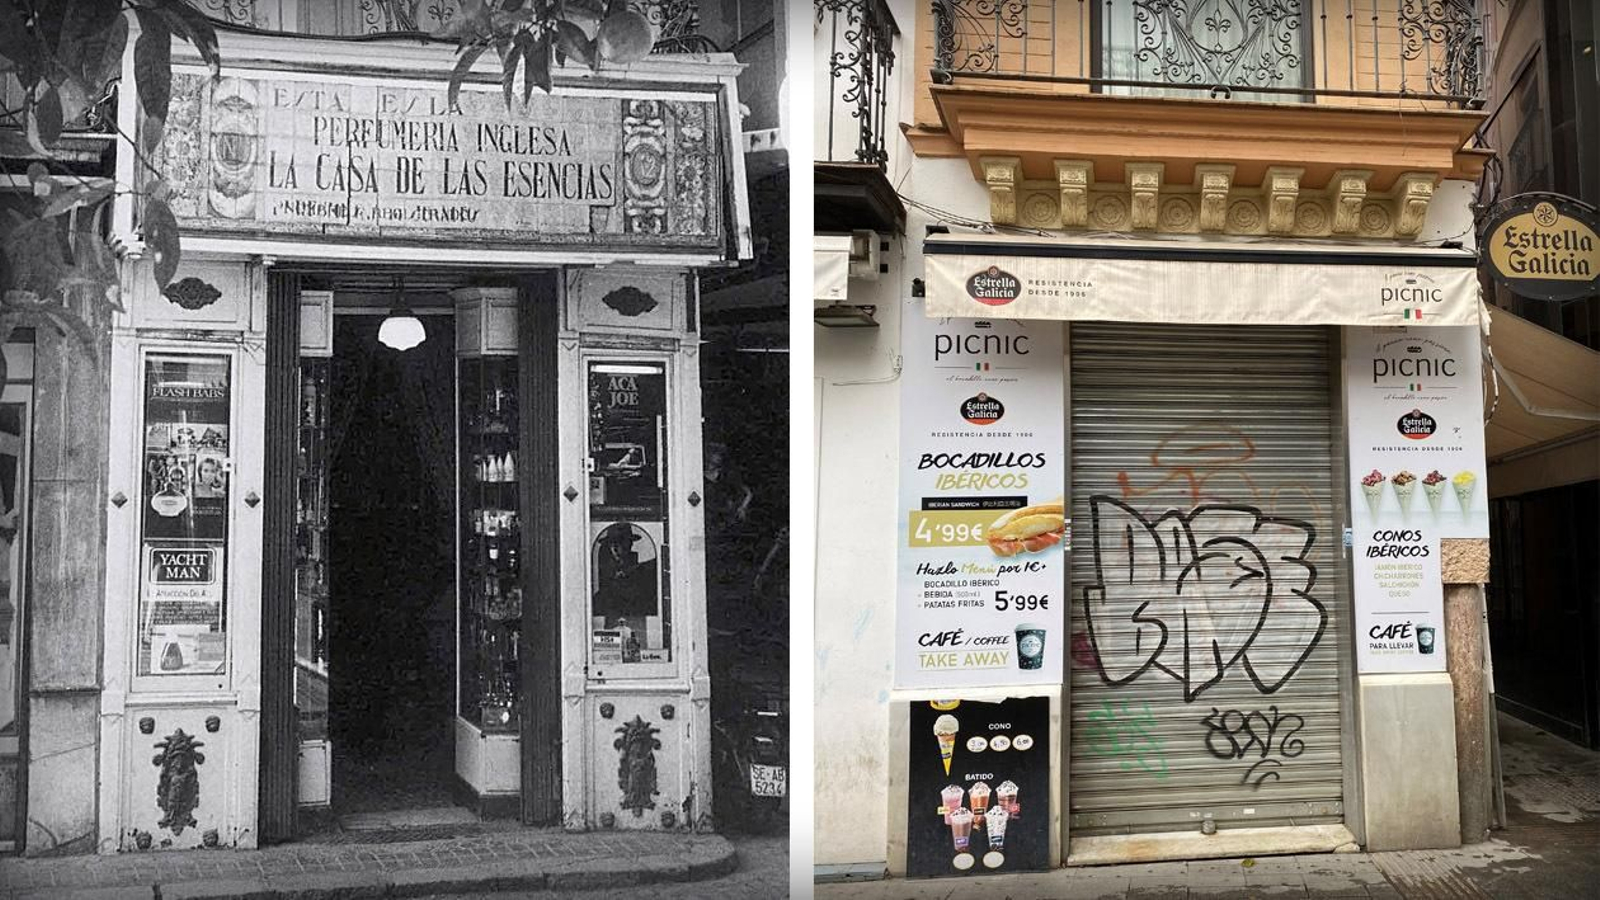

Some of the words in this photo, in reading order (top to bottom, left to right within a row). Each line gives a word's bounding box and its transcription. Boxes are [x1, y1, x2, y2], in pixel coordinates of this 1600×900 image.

[313, 116, 459, 152] PERFUMERIA
[477, 123, 571, 157] INGLESA
[268, 150, 298, 189] LA
[315, 152, 379, 194] CASA
[395, 155, 426, 195] DE
[442, 157, 488, 196] LAS
[502, 160, 613, 201] ESENCIAS
[1502, 225, 1593, 252] Estrella
[1508, 249, 1591, 276] Galicia
[973, 276, 1016, 288] Estrella
[1027, 279, 1094, 288] RESISTENCIA
[974, 287, 1015, 298] Galicia
[1027, 289, 1060, 297] DESDE
[1381, 287, 1443, 307] picnic
[934, 333, 1030, 361] picnic
[1373, 358, 1457, 384] picnic
[607, 376, 638, 391] ACA
[606, 391, 640, 409] JOE
[966, 401, 1000, 411] Estrella
[967, 409, 999, 419] Galicia
[1402, 417, 1433, 427] Estrella
[1403, 425, 1431, 434] Galicia
[917, 451, 1046, 470] BOCADILLOS
[935, 470, 1028, 491] IBÉRICOS
[1372, 529, 1423, 542] CONOS
[1366, 543, 1430, 559] IBÉRICOS
[159, 553, 208, 566] YACHT
[165, 566, 201, 579] MAN
[916, 560, 959, 576] Hazlo
[996, 562, 1022, 577] por
[923, 580, 968, 589] BOCADILLO
[969, 578, 1000, 587] IBÉRICO
[923, 590, 953, 599] BEBIDA
[923, 600, 956, 609] PATATAS
[957, 599, 985, 608] FRITAS
[1368, 620, 1413, 640] CAFÉ
[917, 628, 964, 648] CAFÉ
[973, 635, 1011, 645] COFFEE
[1369, 642, 1388, 650] PARA
[1389, 642, 1414, 650] LLEVAR
[918, 653, 958, 669] TAKE
[963, 651, 1009, 667] AWAY
[988, 723, 1012, 731] CONO
[965, 773, 994, 782] BATIDO
